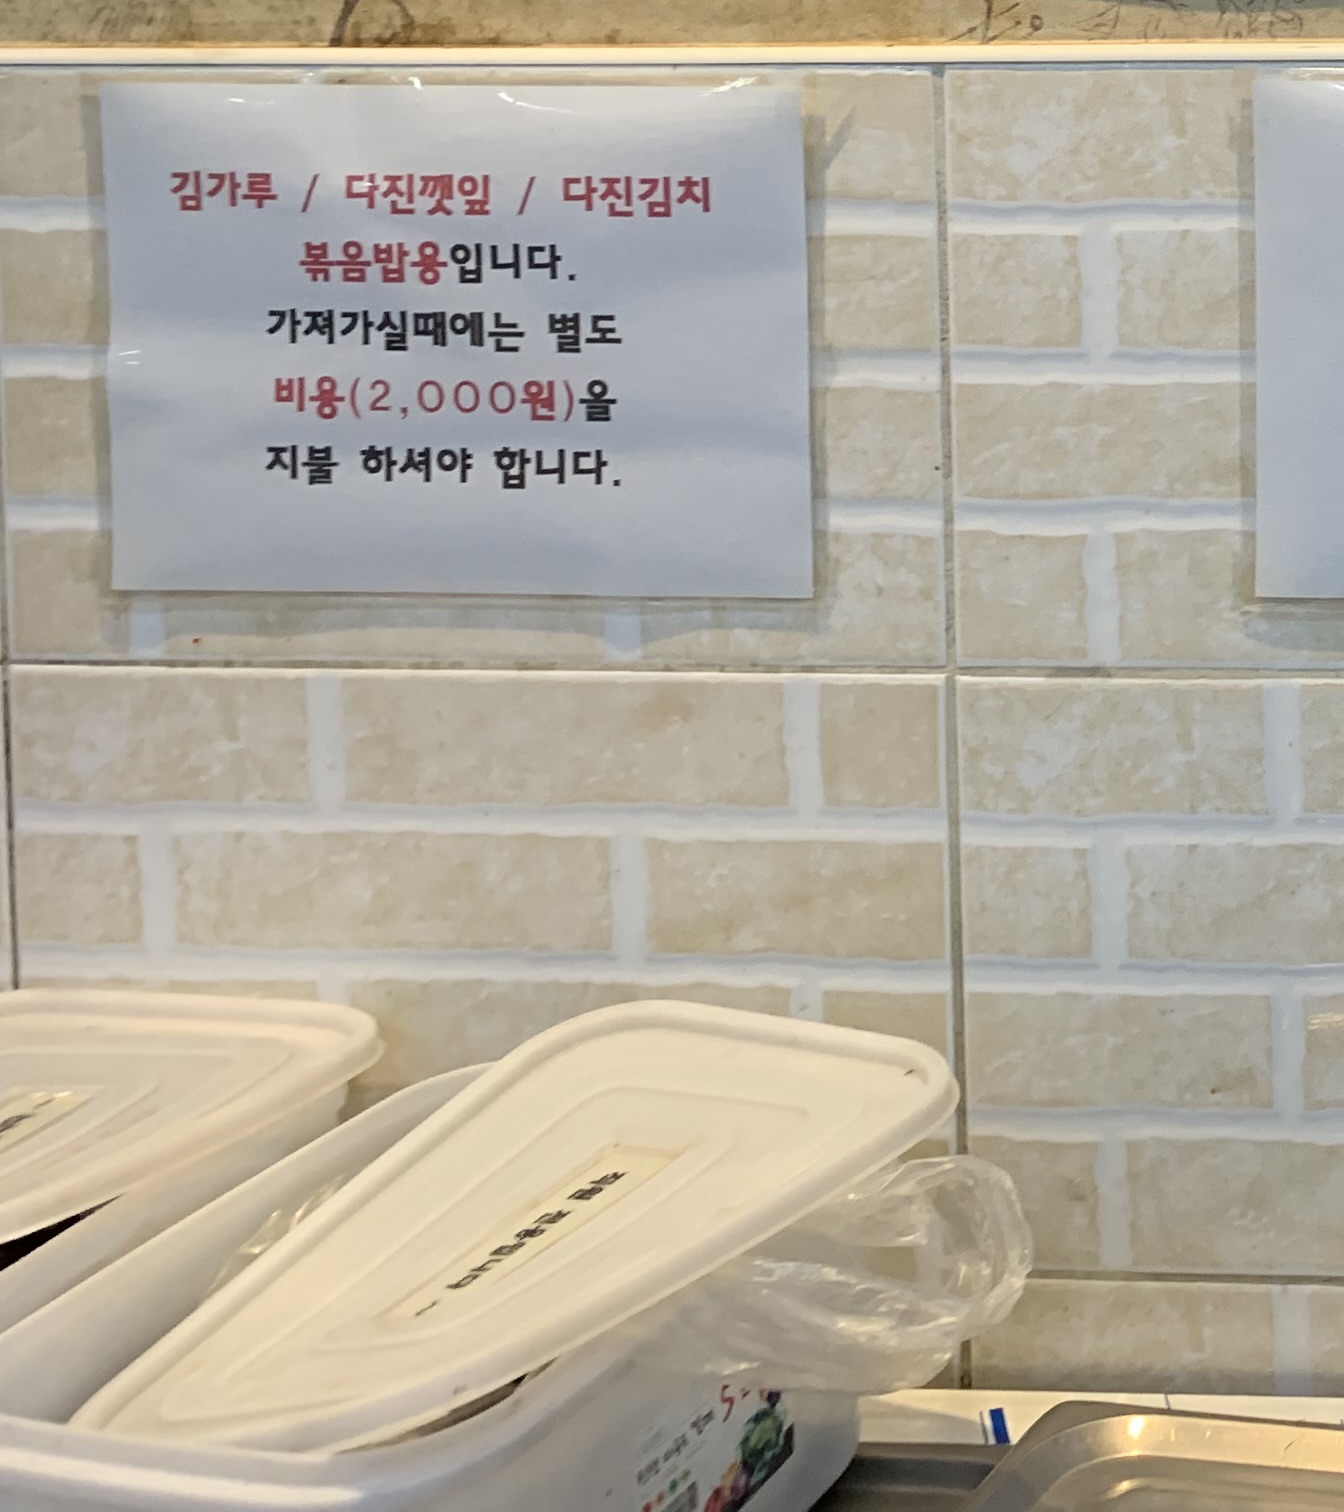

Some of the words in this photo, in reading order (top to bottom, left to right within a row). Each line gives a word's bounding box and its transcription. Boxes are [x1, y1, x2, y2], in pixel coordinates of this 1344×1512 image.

[170, 171, 278, 212] 김가루
[345, 172, 490, 216] 다진깻잎
[561, 174, 712, 218] 다진김치
[298, 240, 577, 284] 볶음밥용입니다.
[264, 307, 526, 352] 가져가실때에는
[548, 311, 623, 354] 별도
[273, 375, 617, 423] 비용(2,000원)을
[264, 443, 338, 486] 지불
[361, 445, 473, 484] 하셔야
[494, 445, 622, 490] 합니다.
